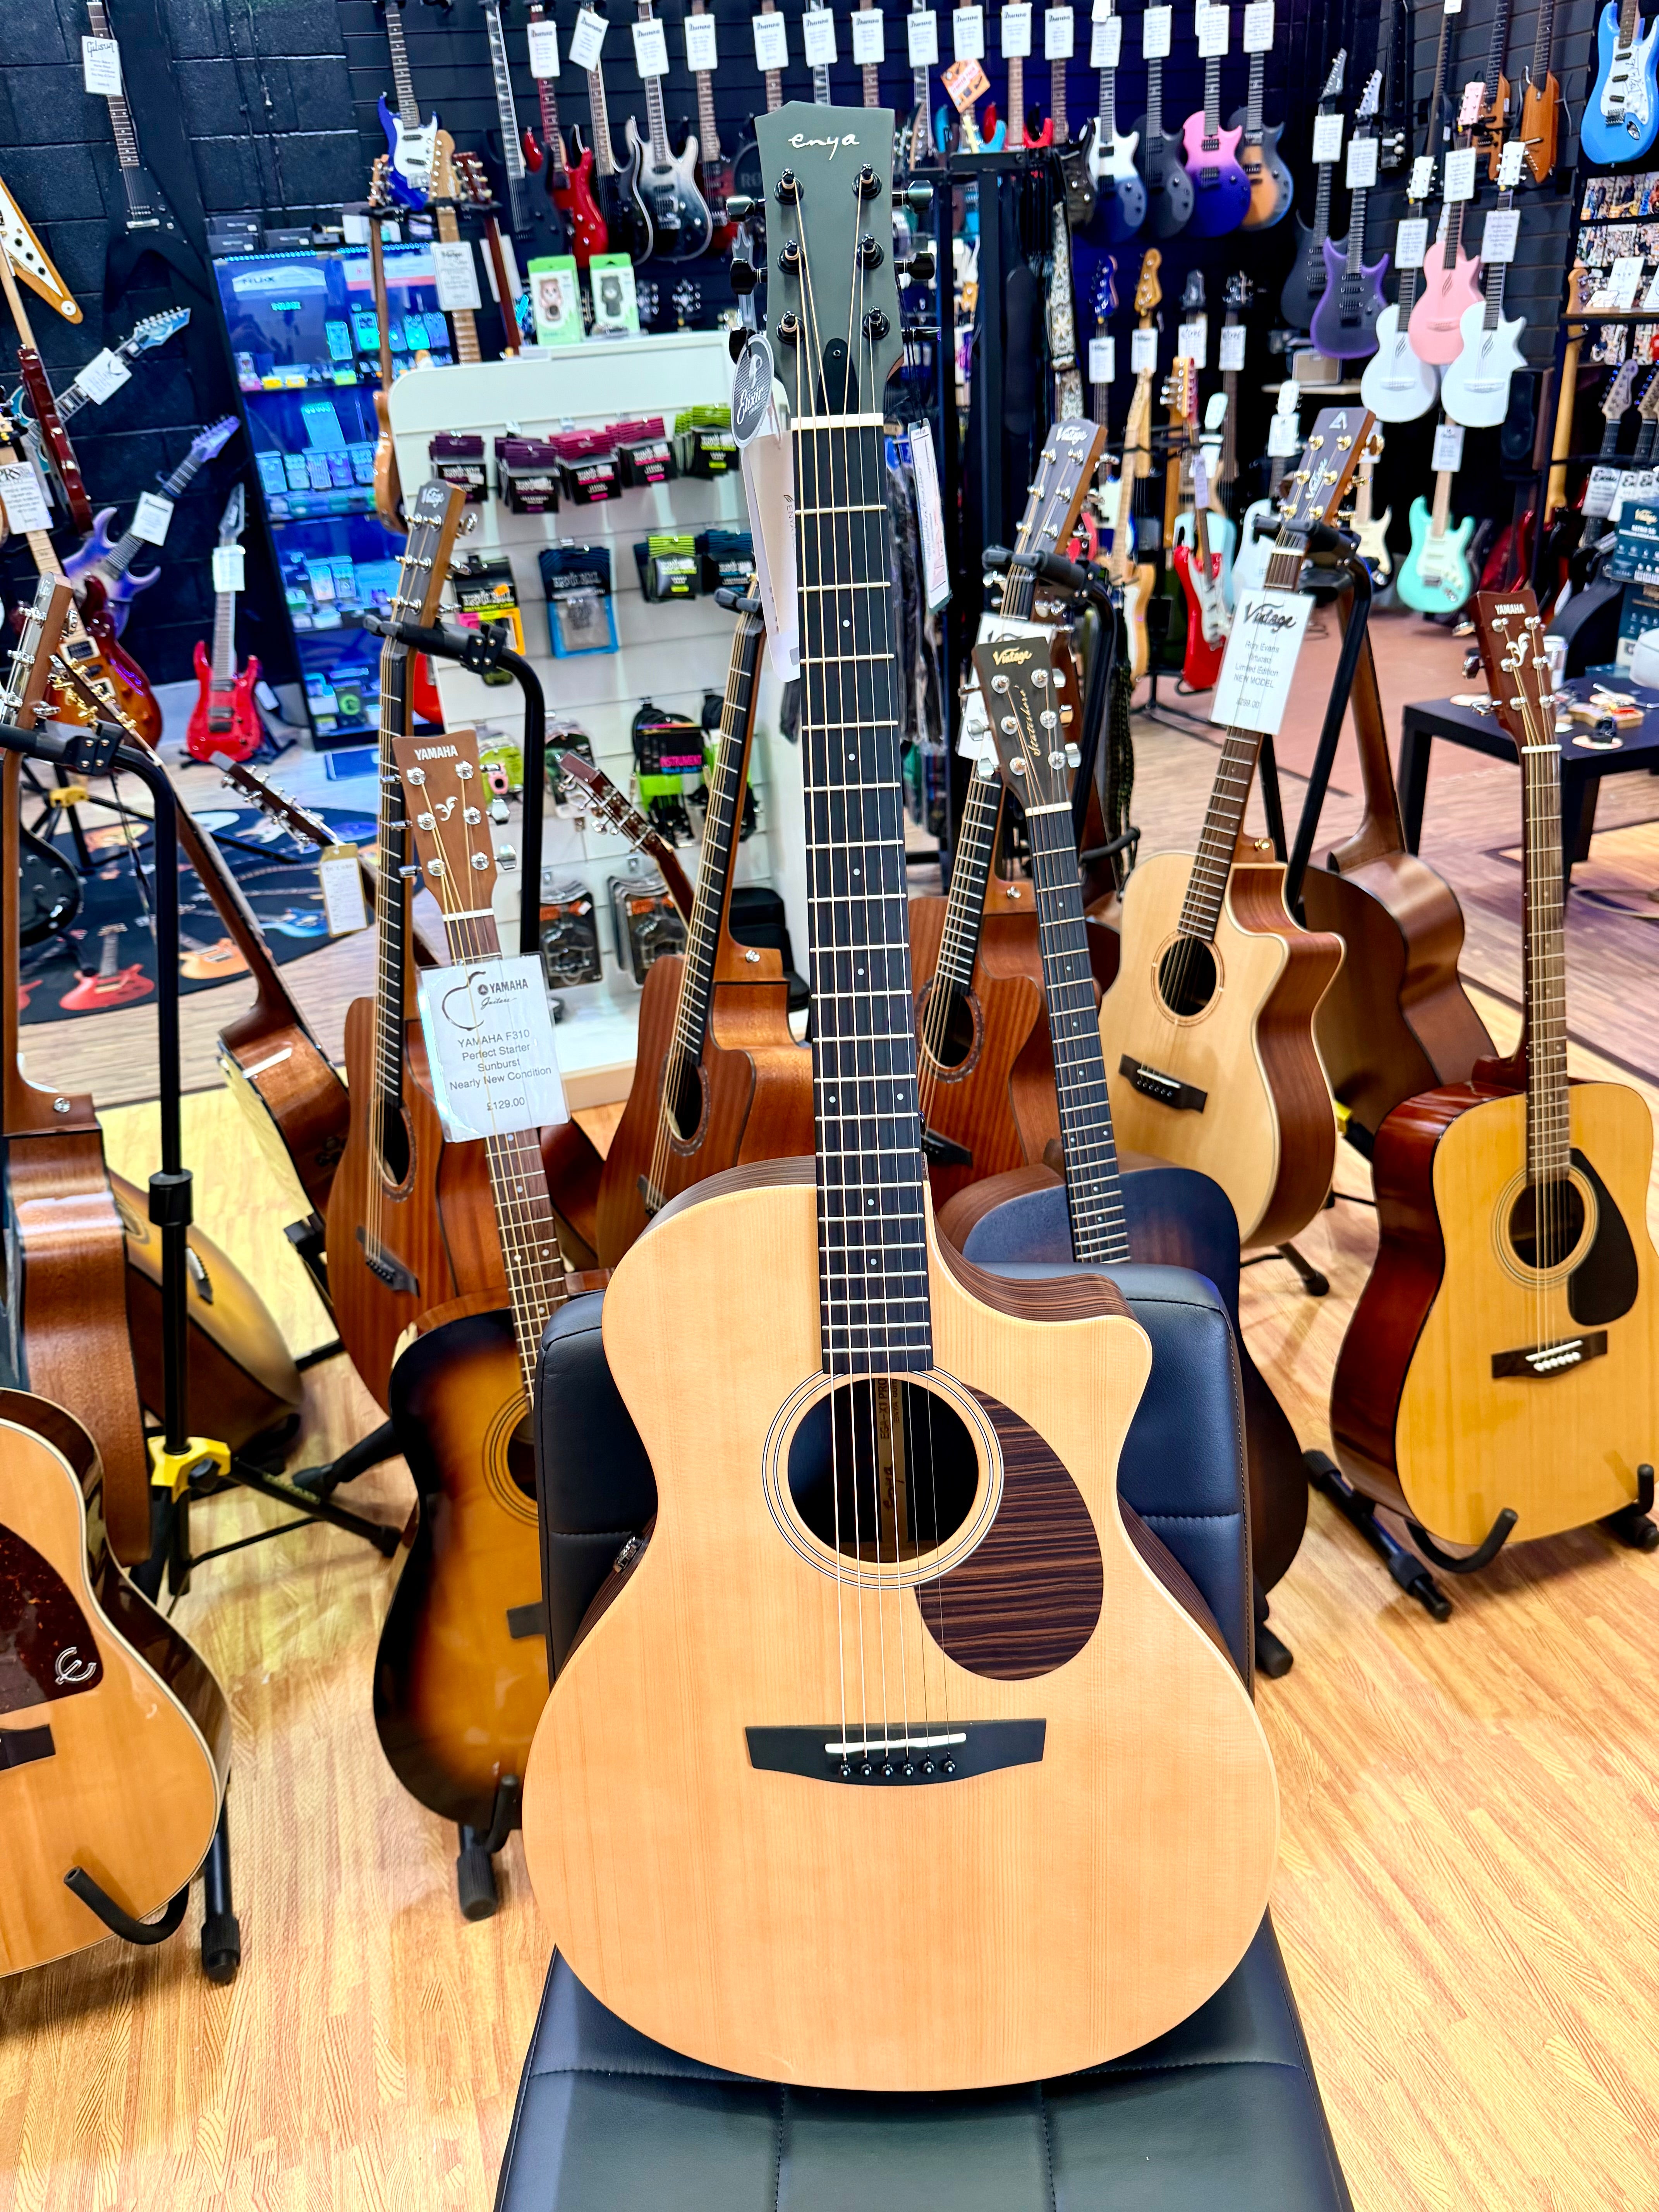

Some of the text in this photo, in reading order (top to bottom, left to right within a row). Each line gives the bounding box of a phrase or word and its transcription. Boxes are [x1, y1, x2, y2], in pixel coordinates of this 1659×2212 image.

[87, 40, 115, 57] Gibson
[788, 133, 860, 160] enya
[737, 387, 764, 425] Elixir
[1243, 601, 1297, 634] Vintage
[1494, 603, 1526, 615] YAMAHA
[993, 647, 1033, 666] Vintage
[1234, 673, 1275, 688] NEW MODEL
[414, 745, 459, 761] YAMAHA
[489, 979, 529, 994] YAMAHA
[457, 1029, 530, 1048] YAMAHA F310
[462, 1043, 530, 1061] Perfect Starter
[477, 1058, 520, 1072] Sunburst
[449, 1067, 552, 1091] Nearly New Condition
[486, 1097, 526, 1111] £129.00
